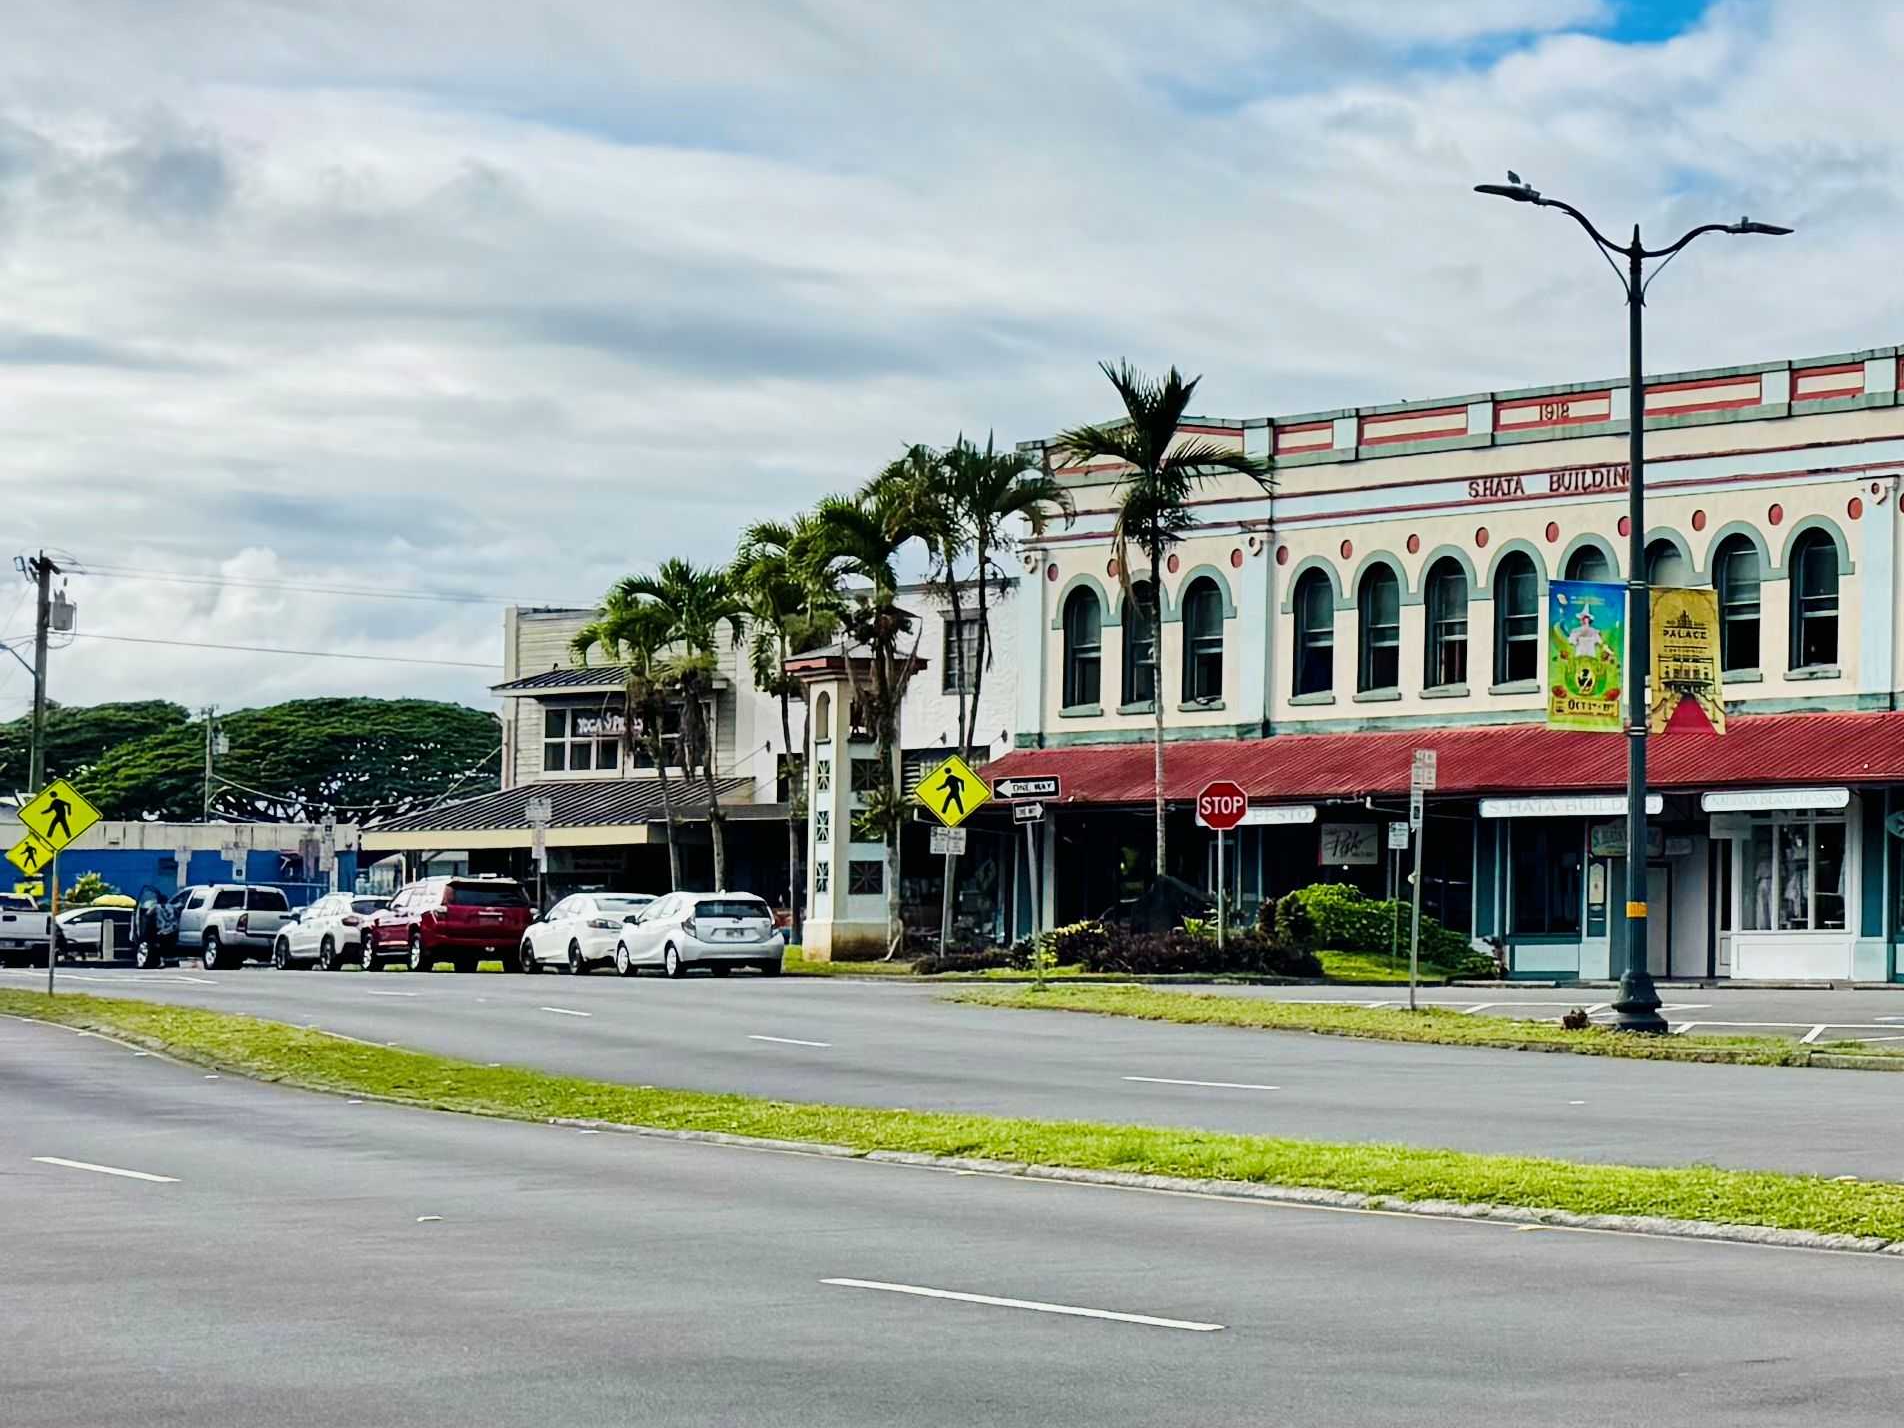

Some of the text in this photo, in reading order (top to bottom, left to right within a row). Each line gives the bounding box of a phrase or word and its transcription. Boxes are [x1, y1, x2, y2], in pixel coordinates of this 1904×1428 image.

[1539, 403, 1570, 421] 1918
[1663, 629, 1707, 639] PALACE
[1201, 796, 1244, 815] STOP
